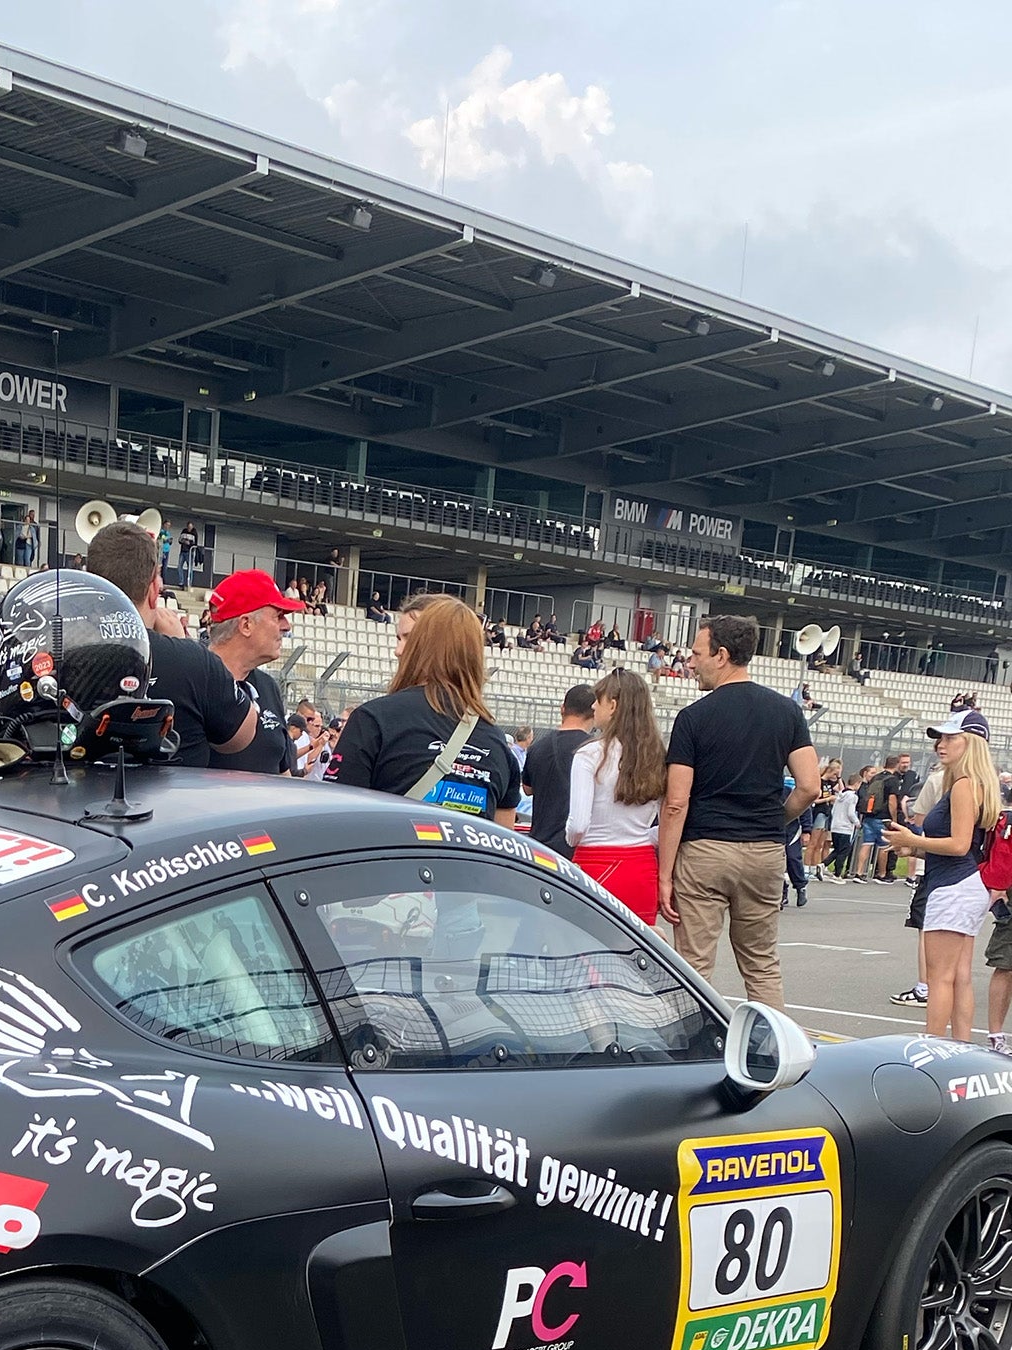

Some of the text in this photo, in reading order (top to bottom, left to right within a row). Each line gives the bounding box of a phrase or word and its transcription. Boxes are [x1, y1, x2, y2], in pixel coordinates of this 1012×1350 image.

[614, 498, 649, 524] BMW
[689, 513, 733, 540] POWER
[10, 634, 47, 664] magic
[34, 659, 51, 672] 2023
[123, 679, 138, 688] BELL
[439, 821, 534, 862] F. Sacchi
[81, 839, 243, 908] C. Knötschke
[556, 856, 579, 881] R.
[949, 1072, 1012, 1103] FALK
[11, 1113, 218, 1228] it's magic
[370, 1095, 530, 1188] Qualität
[536, 1154, 673, 1243] gewinnt!
[706, 1149, 816, 1184] RAVENOL
[714, 1206, 793, 1296] 80
[491, 1260, 588, 1350] PC
